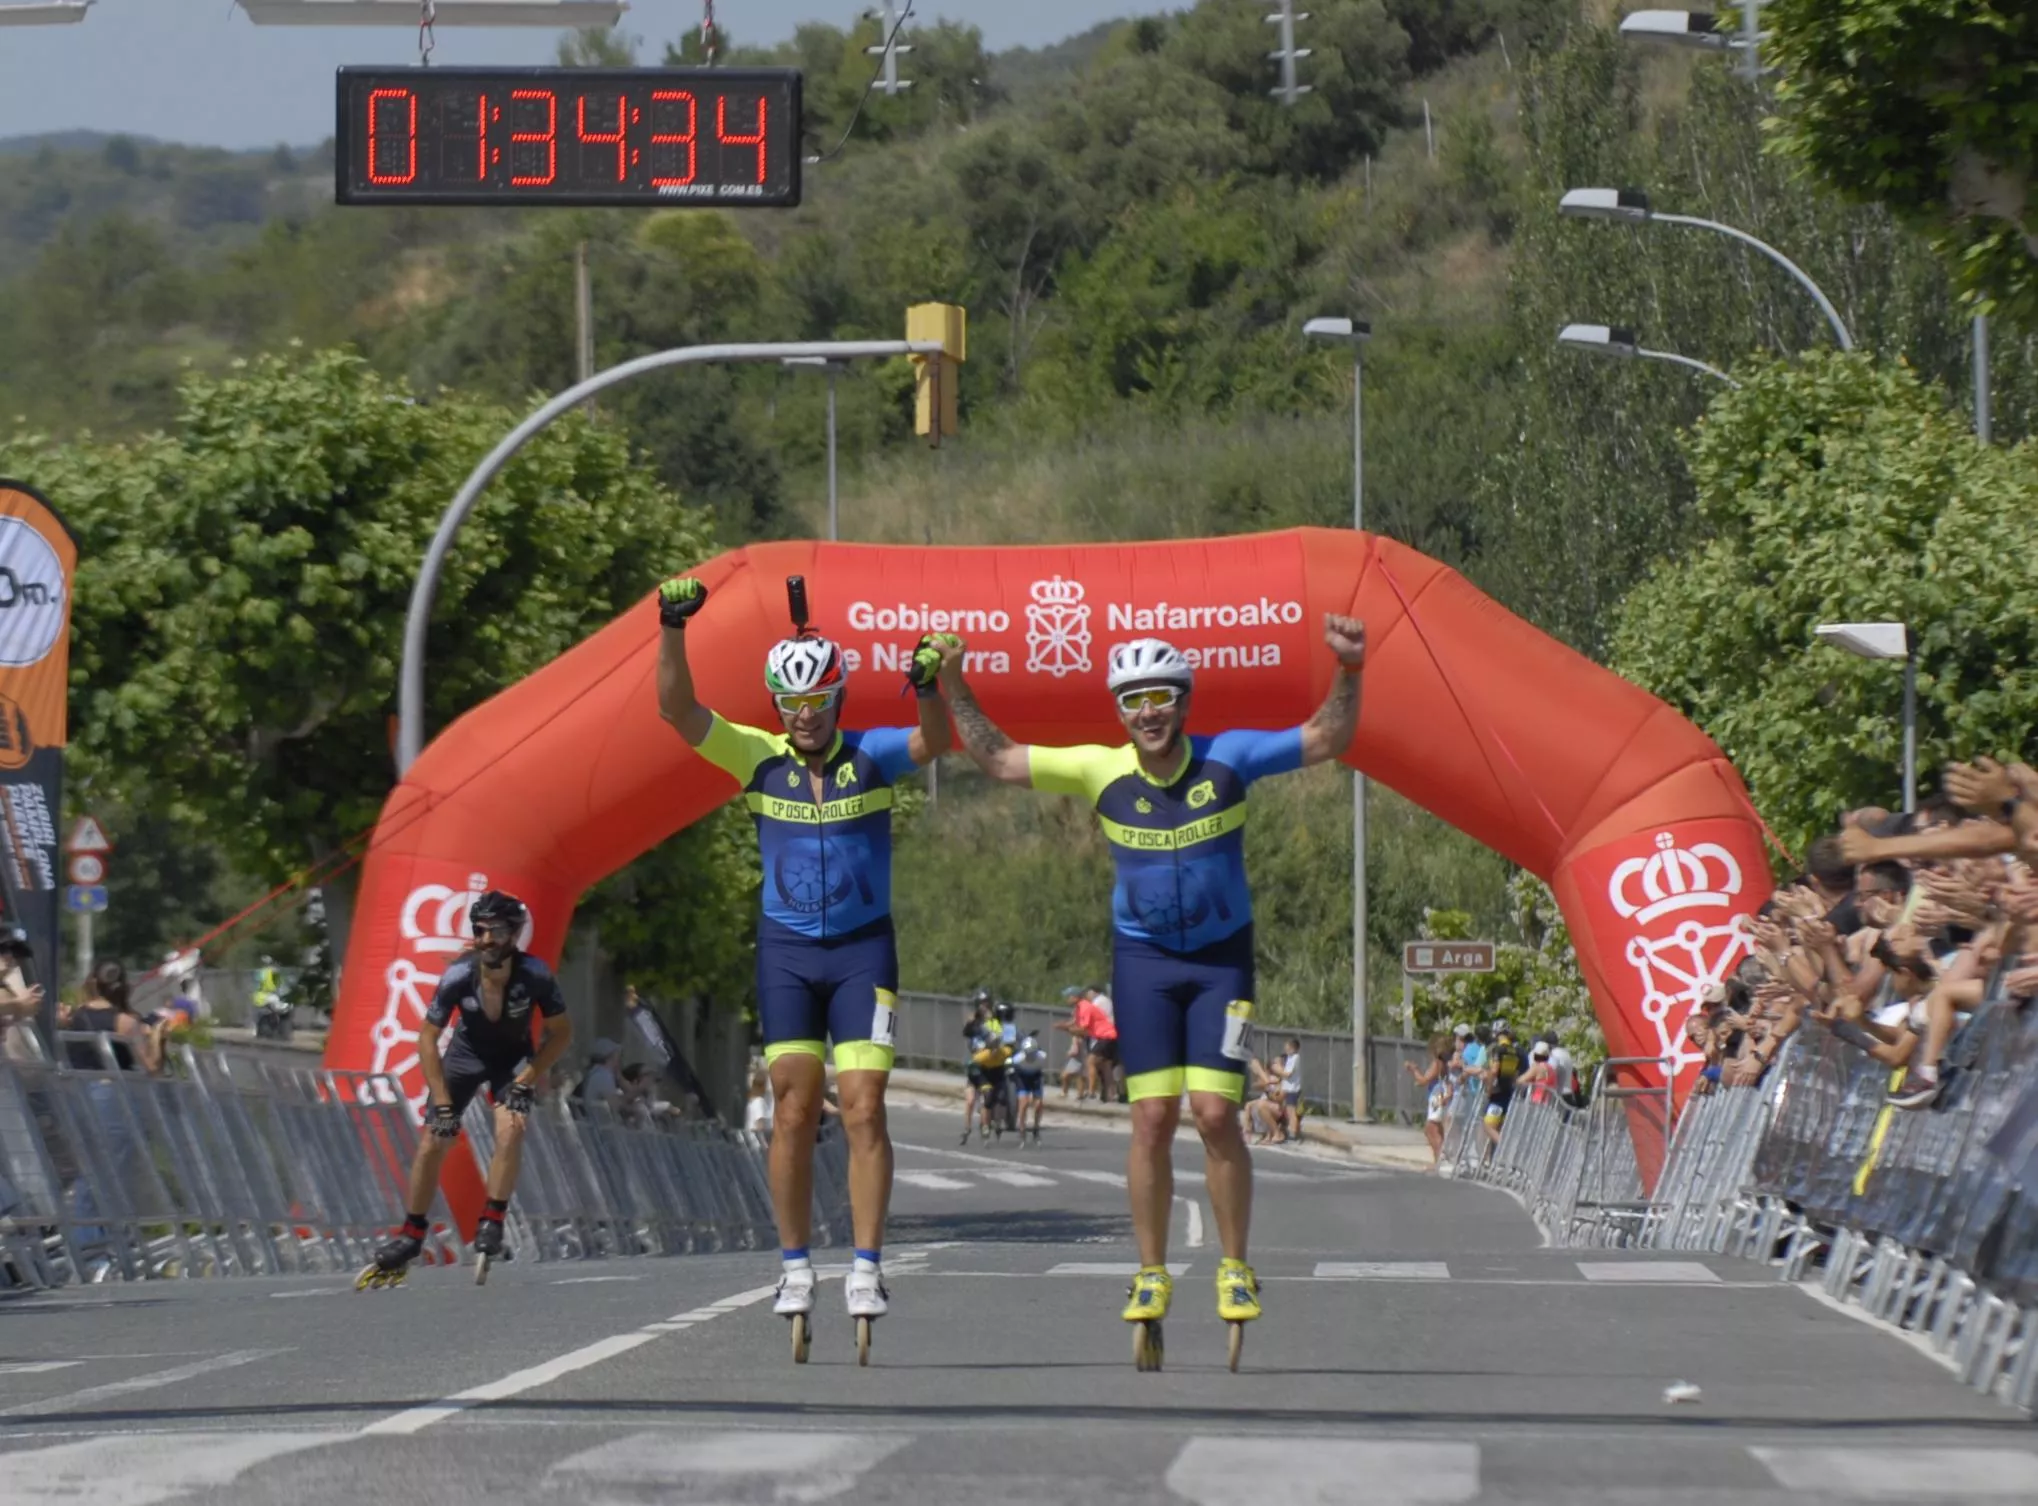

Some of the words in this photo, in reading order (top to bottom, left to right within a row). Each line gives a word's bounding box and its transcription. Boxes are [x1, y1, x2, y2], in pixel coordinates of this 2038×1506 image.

[367, 89, 767, 185] 01:34:34
[848, 601, 1010, 632] Gobierno
[1107, 597, 1303, 631] Nafarroako
[872, 643, 1010, 673] Narra
[822, 799, 864, 819] ROLLER
[1138, 831, 1172, 847] OSCA
[1179, 816, 1223, 844] ROLLER
[1441, 949, 1484, 967] Arga
